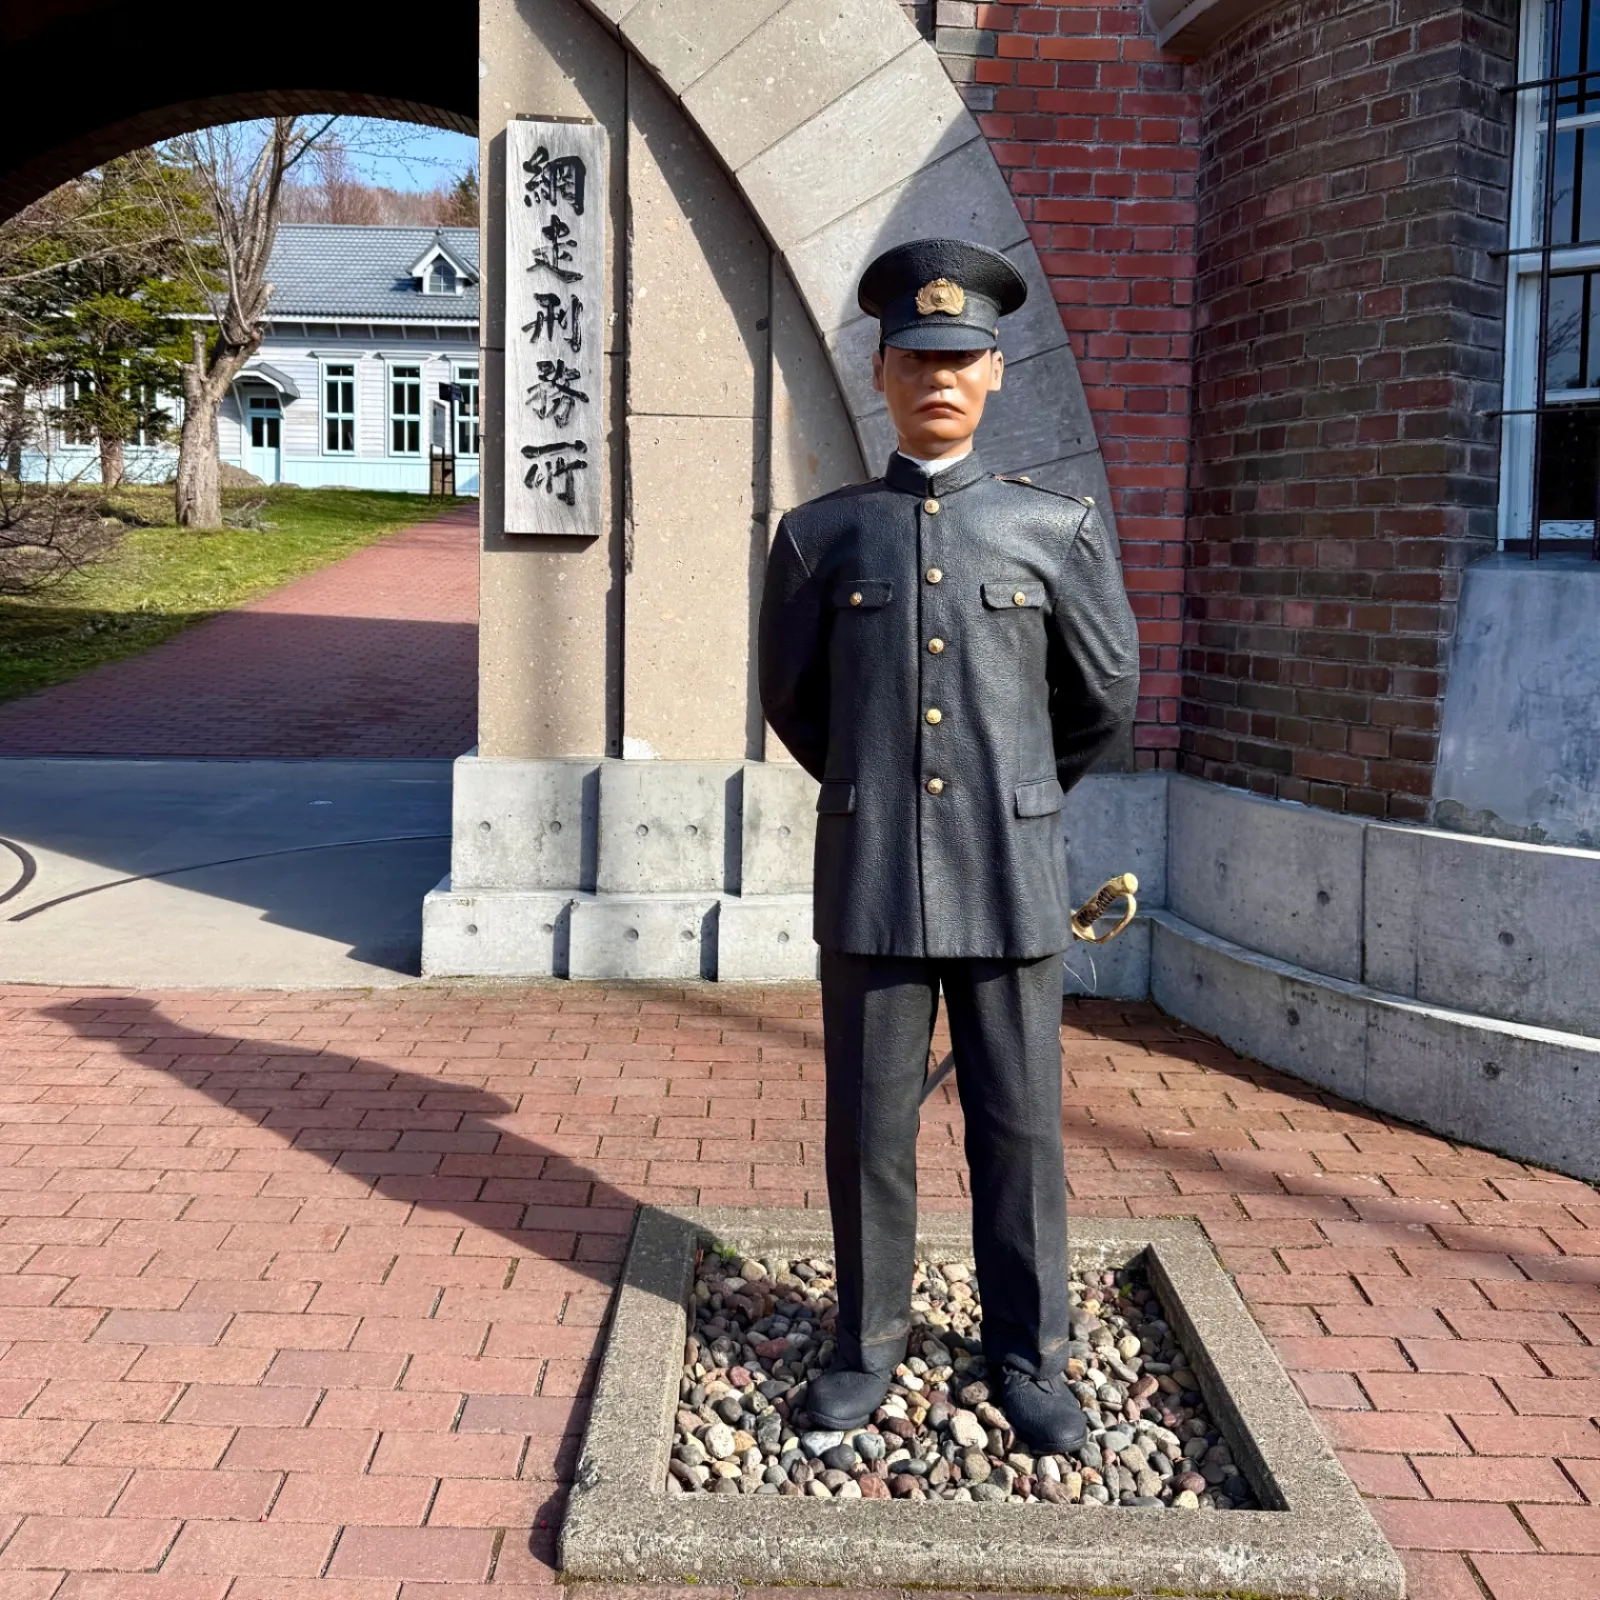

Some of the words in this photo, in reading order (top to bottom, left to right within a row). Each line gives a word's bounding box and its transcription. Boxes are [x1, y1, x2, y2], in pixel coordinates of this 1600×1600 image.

[521, 146, 589, 506] 網走刑務所
